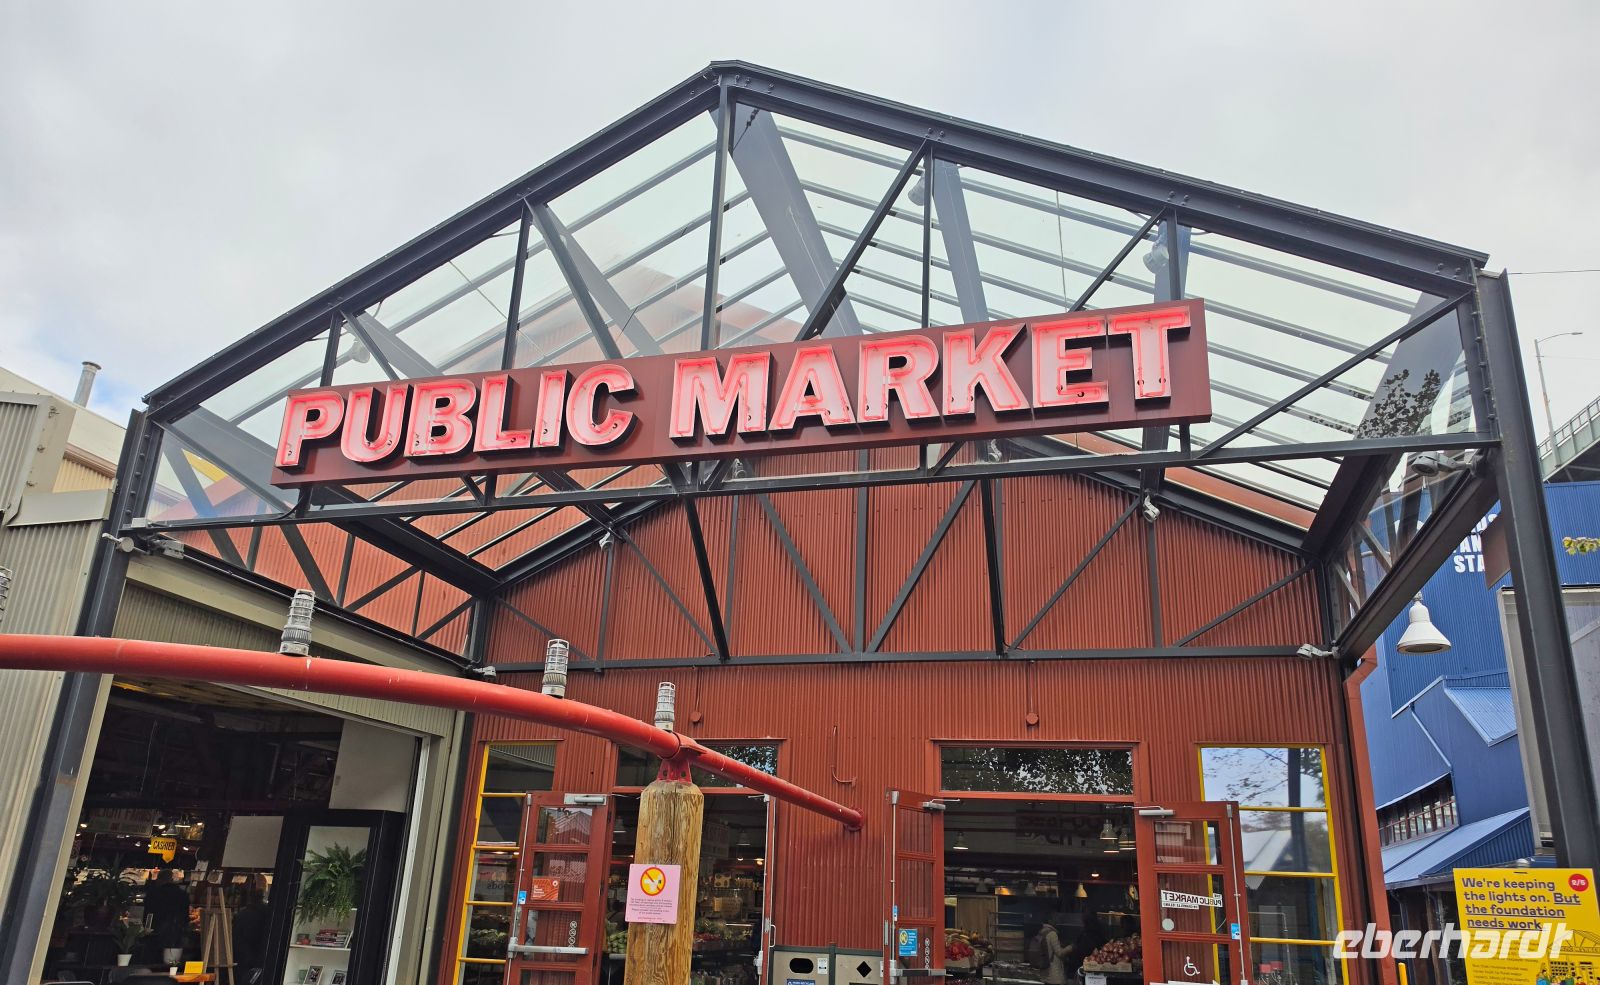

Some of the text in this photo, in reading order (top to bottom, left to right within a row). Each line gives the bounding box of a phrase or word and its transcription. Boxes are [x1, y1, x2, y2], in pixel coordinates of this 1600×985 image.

[275, 306, 1191, 469] PUBLIC MARKET
[1462, 877, 1555, 891] We're keeping
[1464, 891, 1580, 904] the lights on. But
[1465, 904, 1565, 917] the foundation
[1467, 918, 1543, 930] needs work
